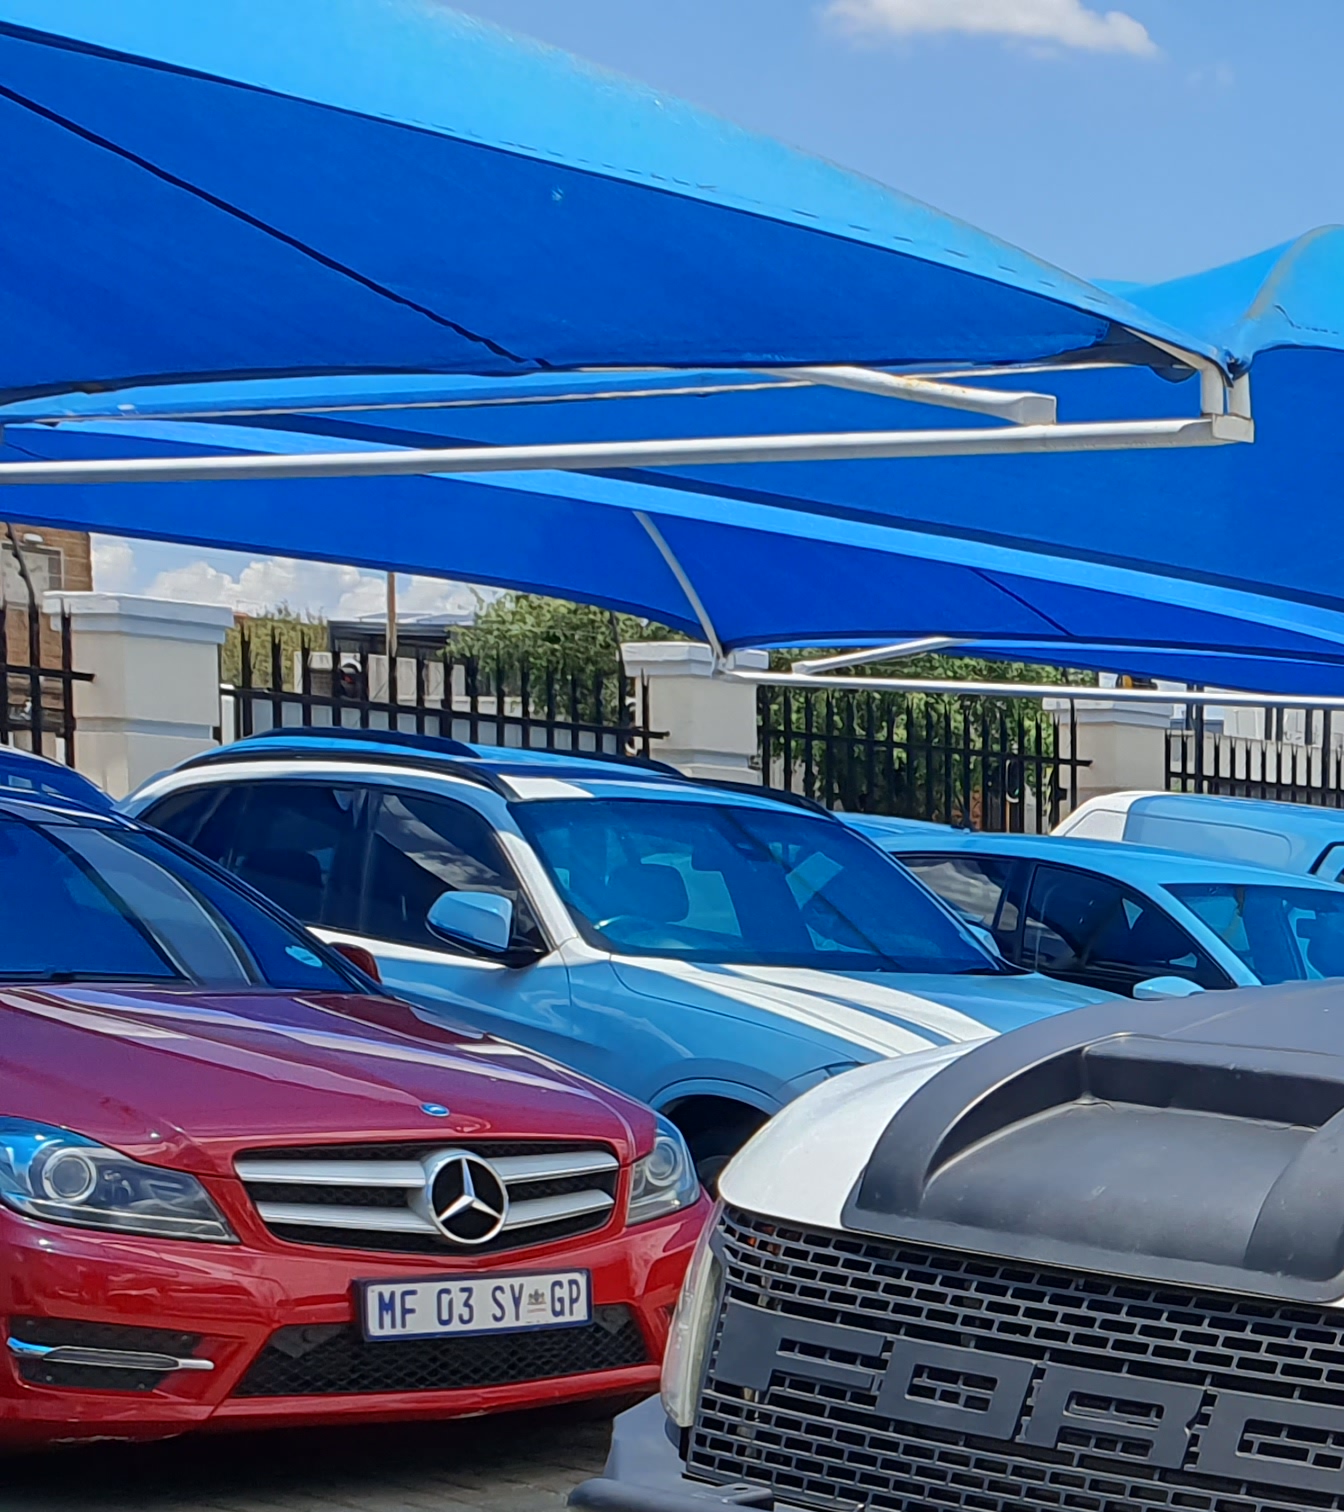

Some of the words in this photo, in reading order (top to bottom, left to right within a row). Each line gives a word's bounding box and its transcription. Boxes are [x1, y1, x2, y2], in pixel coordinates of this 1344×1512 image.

[377, 1289, 418, 1330] MF
[436, 1286, 474, 1327] 03
[491, 1282, 525, 1323] SY
[550, 1278, 581, 1318] GP
